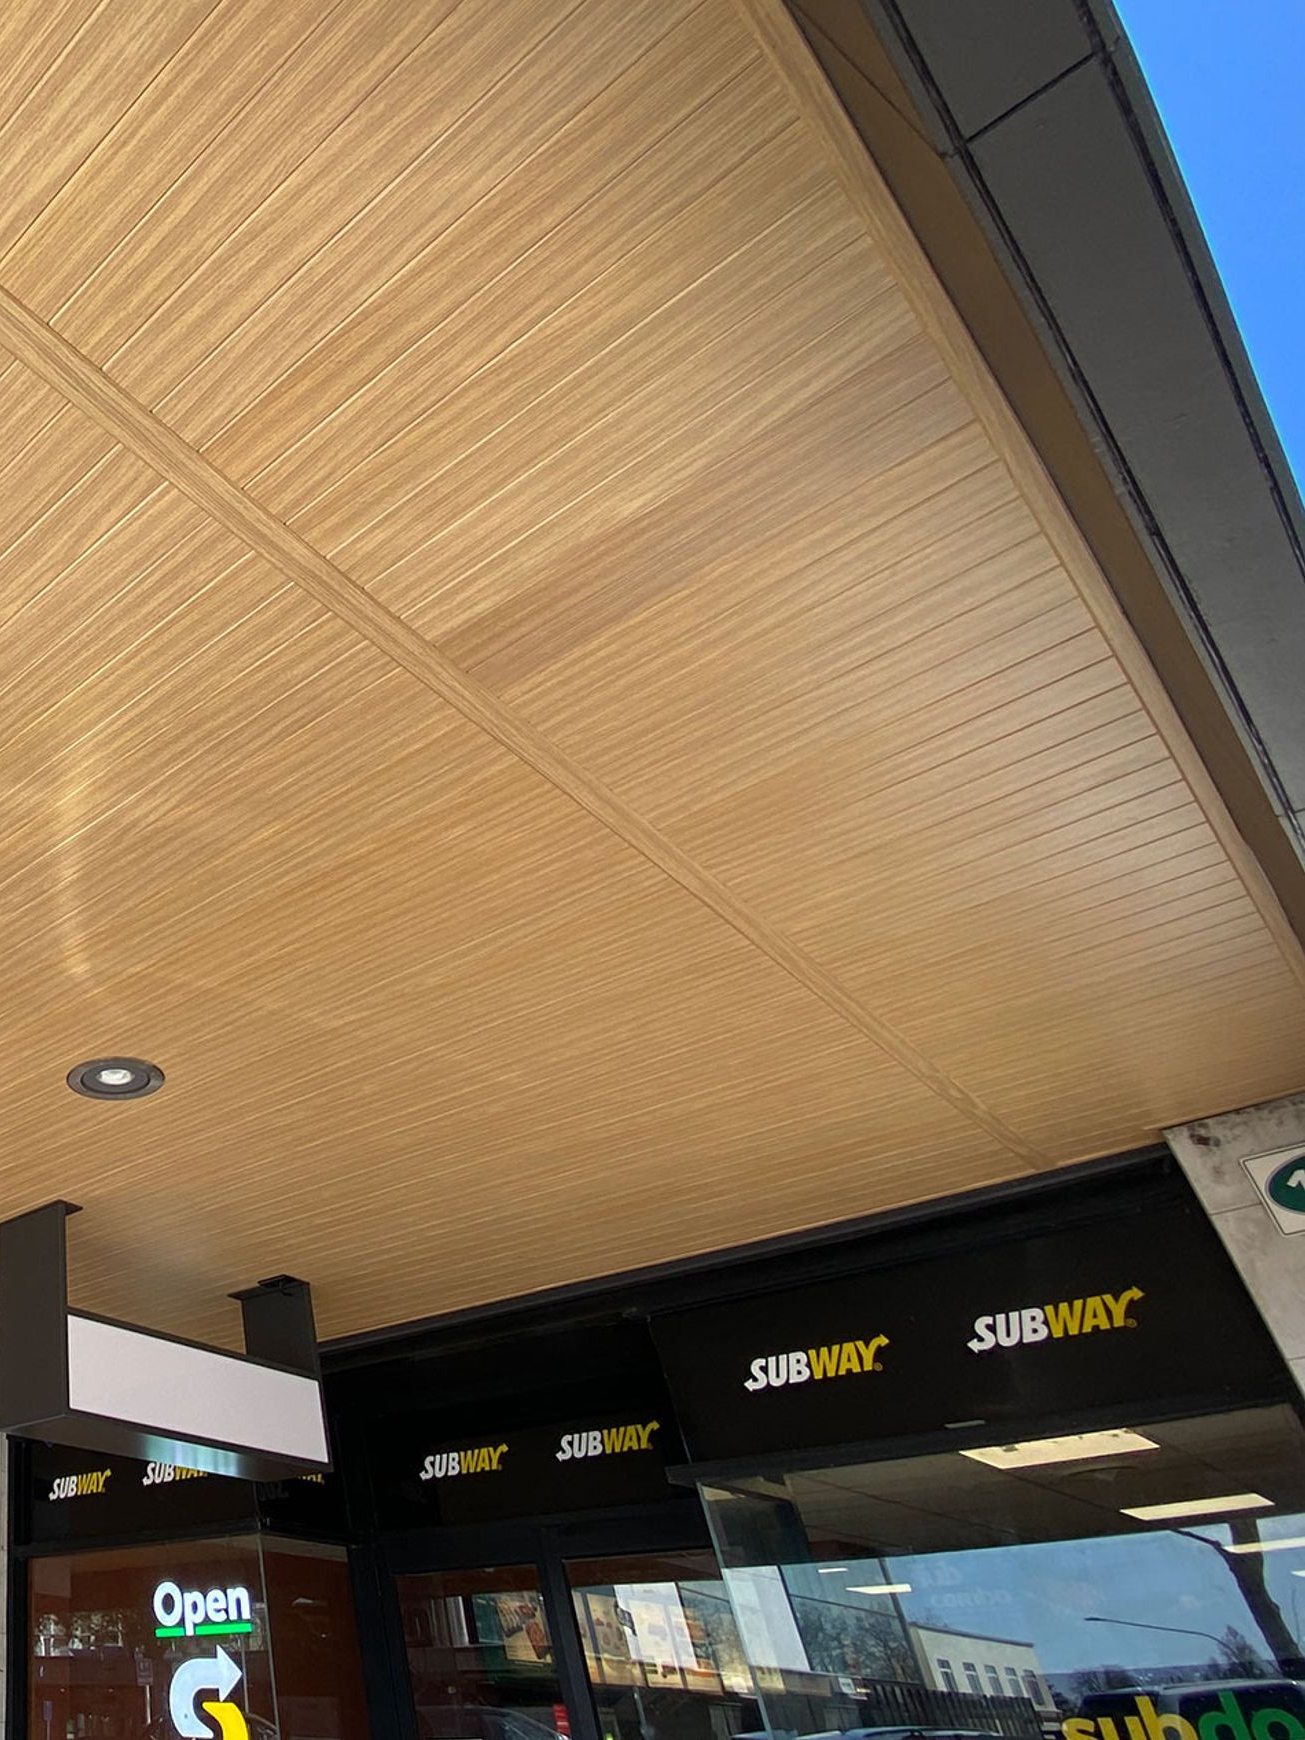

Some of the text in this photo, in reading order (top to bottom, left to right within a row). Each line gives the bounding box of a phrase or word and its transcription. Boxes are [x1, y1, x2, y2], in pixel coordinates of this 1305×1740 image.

[966, 1286, 1145, 1354] SUBWAY
[744, 1333, 890, 1392] SUBWAY
[419, 1443, 509, 1481] SUBWAY
[556, 1420, 661, 1462] SUBWAY
[48, 1468, 112, 1501] SUBWAY
[142, 1462, 208, 1486] SUBW
[153, 1581, 251, 1636] Open
